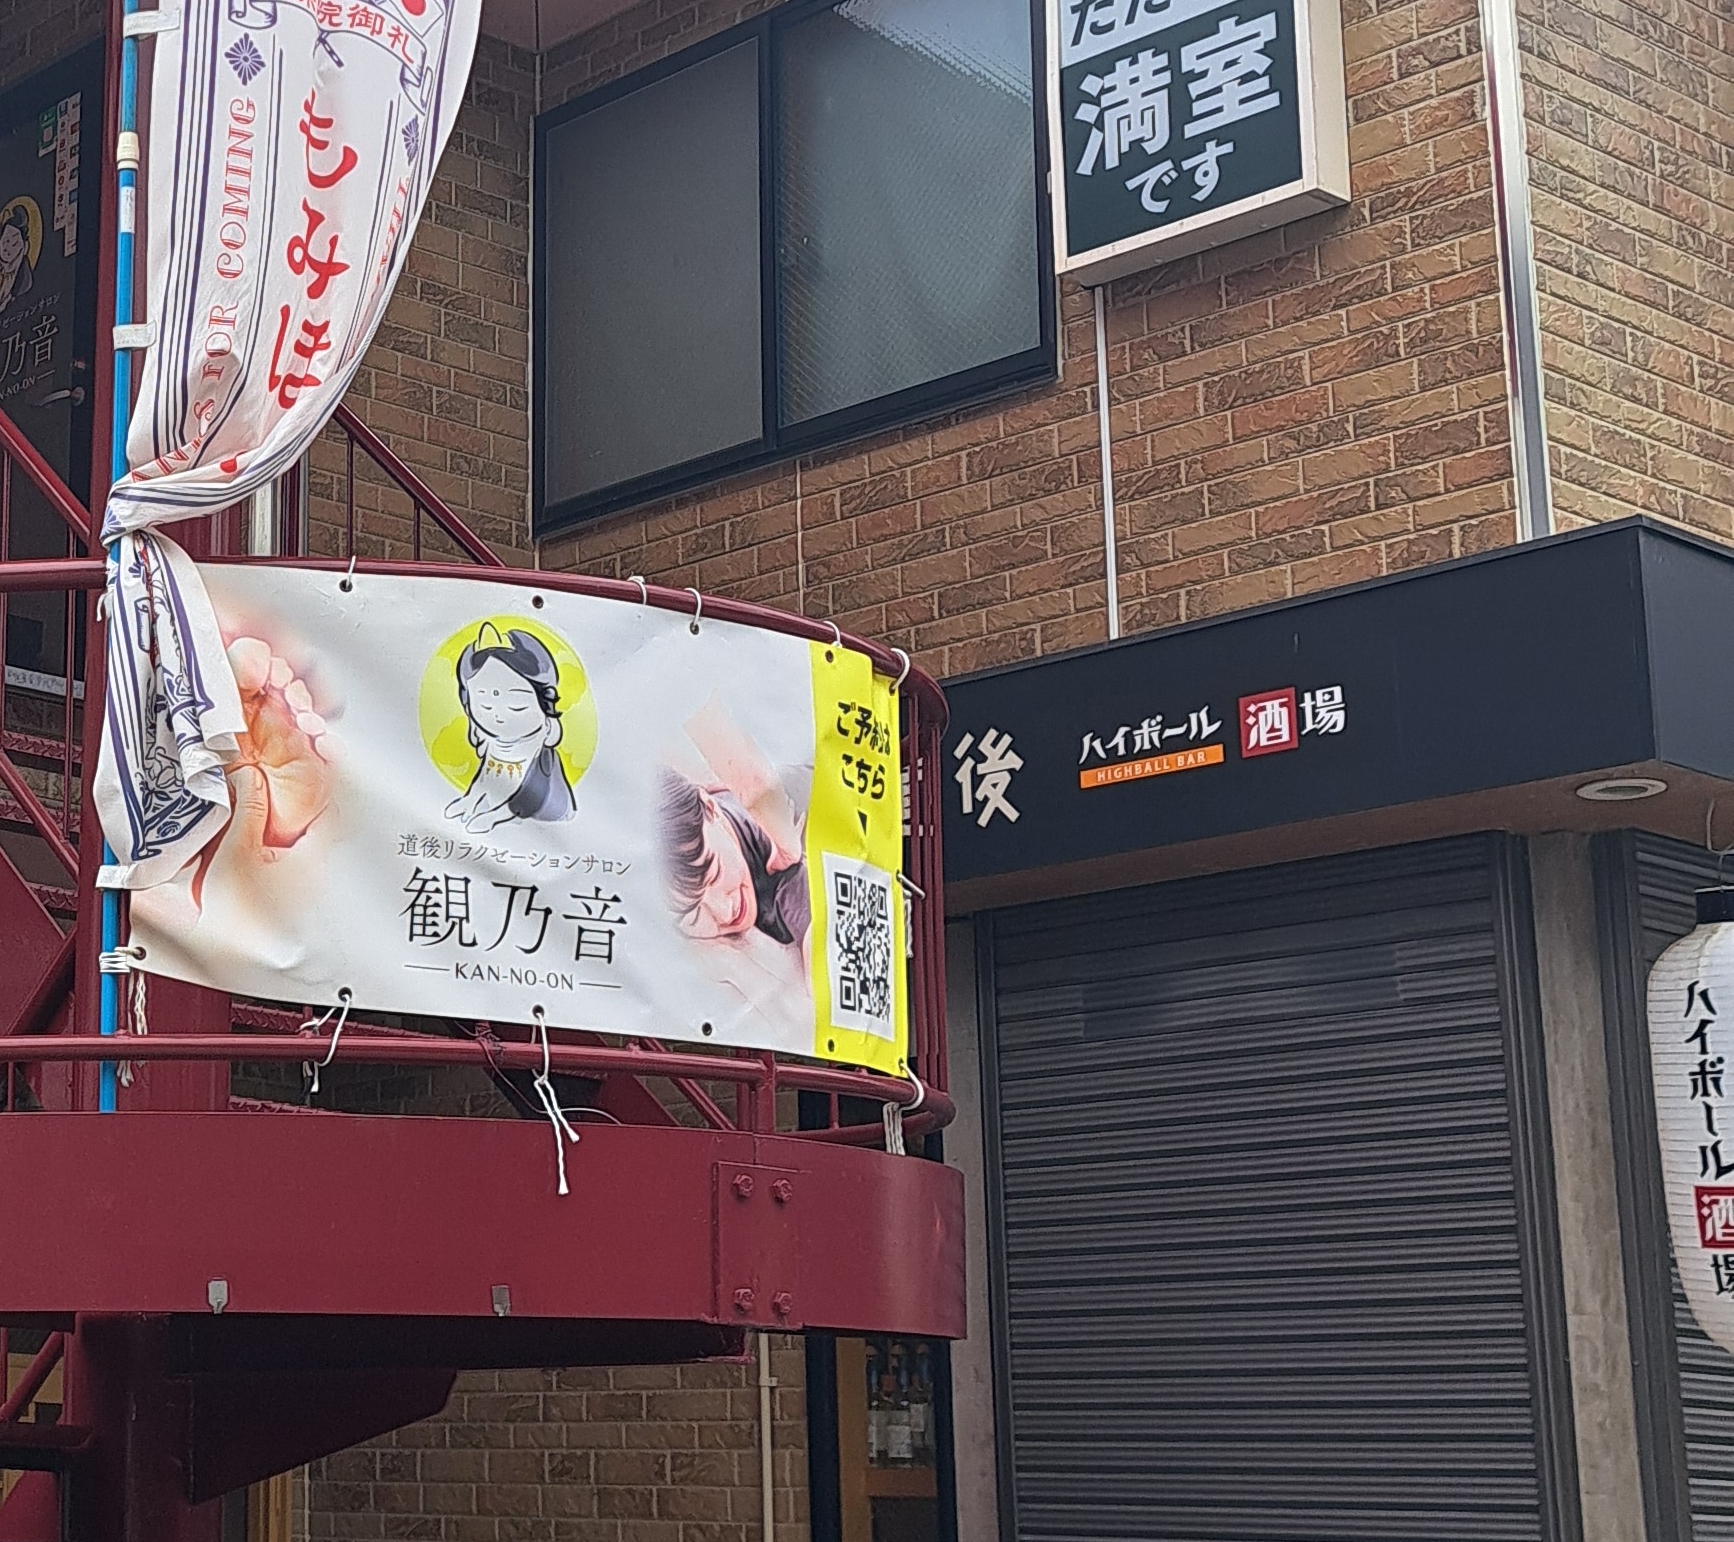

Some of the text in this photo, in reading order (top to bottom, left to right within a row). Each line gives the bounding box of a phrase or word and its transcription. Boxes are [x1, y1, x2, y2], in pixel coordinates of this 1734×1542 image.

[1074, 11, 1281, 176] 満室
[216, 98, 257, 279] COMING
[1125, 139, 1235, 214] です
[202, 300, 239, 381] FOR
[1078, 685, 1346, 764] ハイボール 酒場
[841, 753, 886, 800] こちら
[1096, 751, 1206, 782] HIGHBALL BAR
[397, 833, 632, 876] 道後リラクゼーションサロン
[398, 866, 627, 964] 観乃音
[455, 962, 574, 991] KAN-NO-ON
